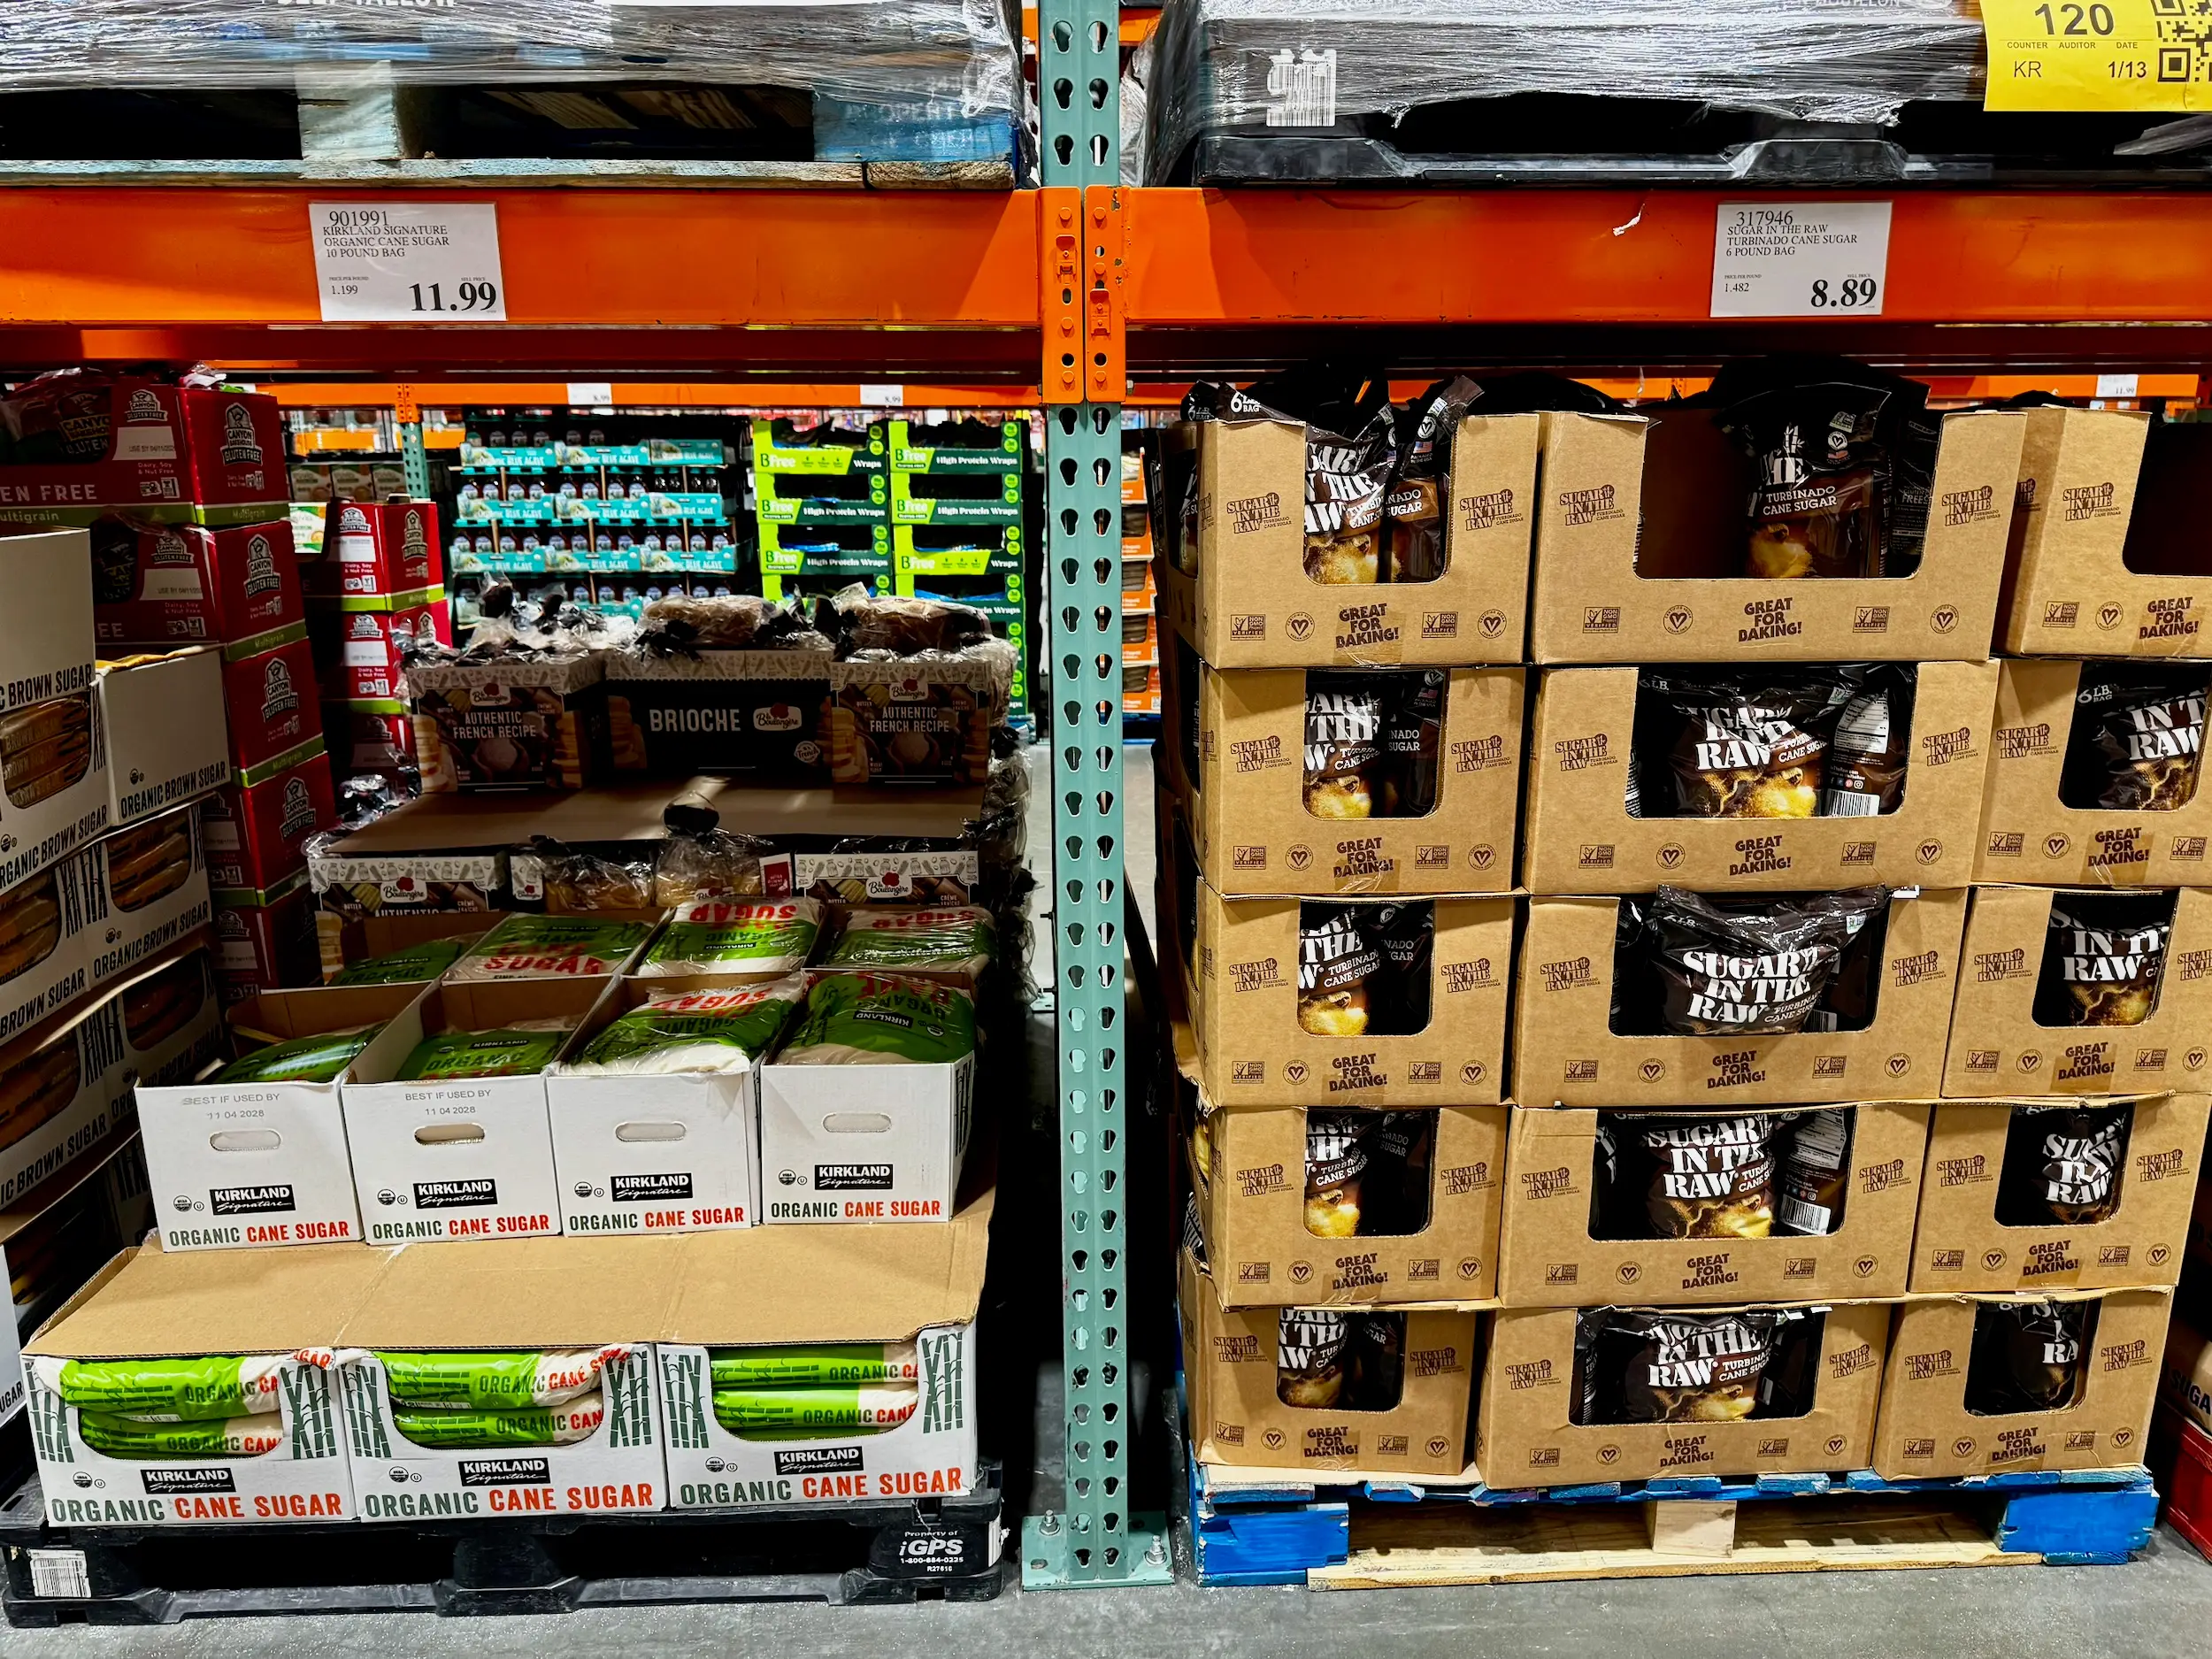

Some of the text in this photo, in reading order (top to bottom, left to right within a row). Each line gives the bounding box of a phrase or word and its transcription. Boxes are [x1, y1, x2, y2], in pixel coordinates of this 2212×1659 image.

[2035, 4, 2115, 35] 120
[2014, 61, 2147, 78] KR 1/13
[329, 211, 389, 227] 901991
[1736, 211, 1793, 227] 317946
[323, 226, 448, 235] KIRKLAND SIGNATURE
[1728, 227, 1763, 235] SUGAR
[1766, 226, 1778, 234] IN
[1804, 225, 1829, 234] RAW
[324, 237, 449, 246] ORGANIC CANE SUGAR
[1727, 235, 1858, 245] TURBINADO CANE SUGAR
[341, 249, 379, 257] POUND
[331, 285, 357, 295] 1.199
[1724, 283, 1749, 292] 1.482
[1810, 279, 1877, 307] 8.89
[409, 281, 496, 311] 11.99
[227, 429, 253, 441] CANYON
[224, 449, 262, 463] GLUTEN FREE
[854, 459, 882, 469] Wraps
[937, 457, 956, 465] High
[42, 484, 97, 501] FREE
[1765, 485, 1836, 503] TURBINADO
[1227, 495, 1270, 513] SUGAR
[1763, 495, 1838, 516] CANE SUGAR
[0, 511, 59, 524] ultigrain
[1235, 505, 1280, 522] IN THE
[1233, 519, 1261, 534] RAW
[1744, 597, 1793, 615] GREAT
[1755, 610, 1785, 626] FOR
[2078, 685, 2112, 704] 6 LB.
[2093, 694, 2112, 703] BAG
[465, 711, 522, 725] AUTHENTIC
[649, 708, 741, 733] BRIOCHE
[2131, 706, 2172, 733] IN
[454, 725, 536, 740] FRENCH RECIPE
[2128, 726, 2202, 761] RAW
[1695, 739, 1771, 772] RAW
[120, 761, 227, 819] ORGANIC BROWN SUGAR
[689, 903, 797, 924] SUGAR
[94, 901, 209, 979] ORGANIC BROWN SUGAR
[2074, 931, 2113, 956] IN
[485, 955, 606, 973] SUGAR
[1683, 947, 1804, 980] SUGAR
[2063, 956, 2145, 982] RAW
[1706, 973, 1811, 1003] IN THE
[1686, 993, 1767, 1024] RAW
[856, 1010, 910, 1027] KIRKLAND
[1712, 1050, 1758, 1068] GREAT
[1721, 1062, 1752, 1078] FOR
[404, 1089, 492, 1102] BEST IF USED BY
[425, 1105, 476, 1117] 11 04 2028
[818, 1165, 891, 1179] KIRKLAND
[418, 1180, 493, 1196] KIRKLAND
[819, 1178, 891, 1188] Signature
[1663, 1172, 1738, 1197] RAW
[214, 1187, 290, 1202] KIRKLAND
[420, 1194, 496, 1207] Signature
[217, 1201, 294, 1213] Signature
[771, 1200, 941, 1218] ORGANIC CANE SUGAR
[169, 1221, 350, 1248] ORGANIC CANE SUGAR
[373, 1214, 550, 1240] ORGANIC CANE SUGAR
[2029, 1240, 2071, 1256] GREAT
[2038, 1250, 2064, 1264] FOR
[480, 1366, 586, 1394] ORGANIC CANE
[829, 1365, 899, 1381] ORGANIC
[0, 1380, 24, 1414] UGAR
[185, 1380, 256, 1402] ORGANIC
[496, 1409, 603, 1434] ORGANIC CAN
[803, 1409, 872, 1424] ORGANIC
[1307, 1426, 1348, 1438] GREAT
[166, 1436, 241, 1451] ORGANIC
[1317, 1436, 1343, 1448] FOR
[779, 1448, 860, 1463] KIRKLAND
[464, 1460, 546, 1474] KIRKLAND
[780, 1461, 861, 1473] Signature
[146, 1470, 229, 1482] KIRKLAND
[465, 1472, 547, 1484] Signature
[148, 1480, 233, 1494] Signature
[680, 1467, 962, 1505] ORGANIC CANE SUGAR
[51, 1493, 342, 1523] ORGANIC CANE SUGAR
[365, 1483, 653, 1517] ORGANIC CANE SUGAR
[899, 1540, 964, 1555] iGPS
